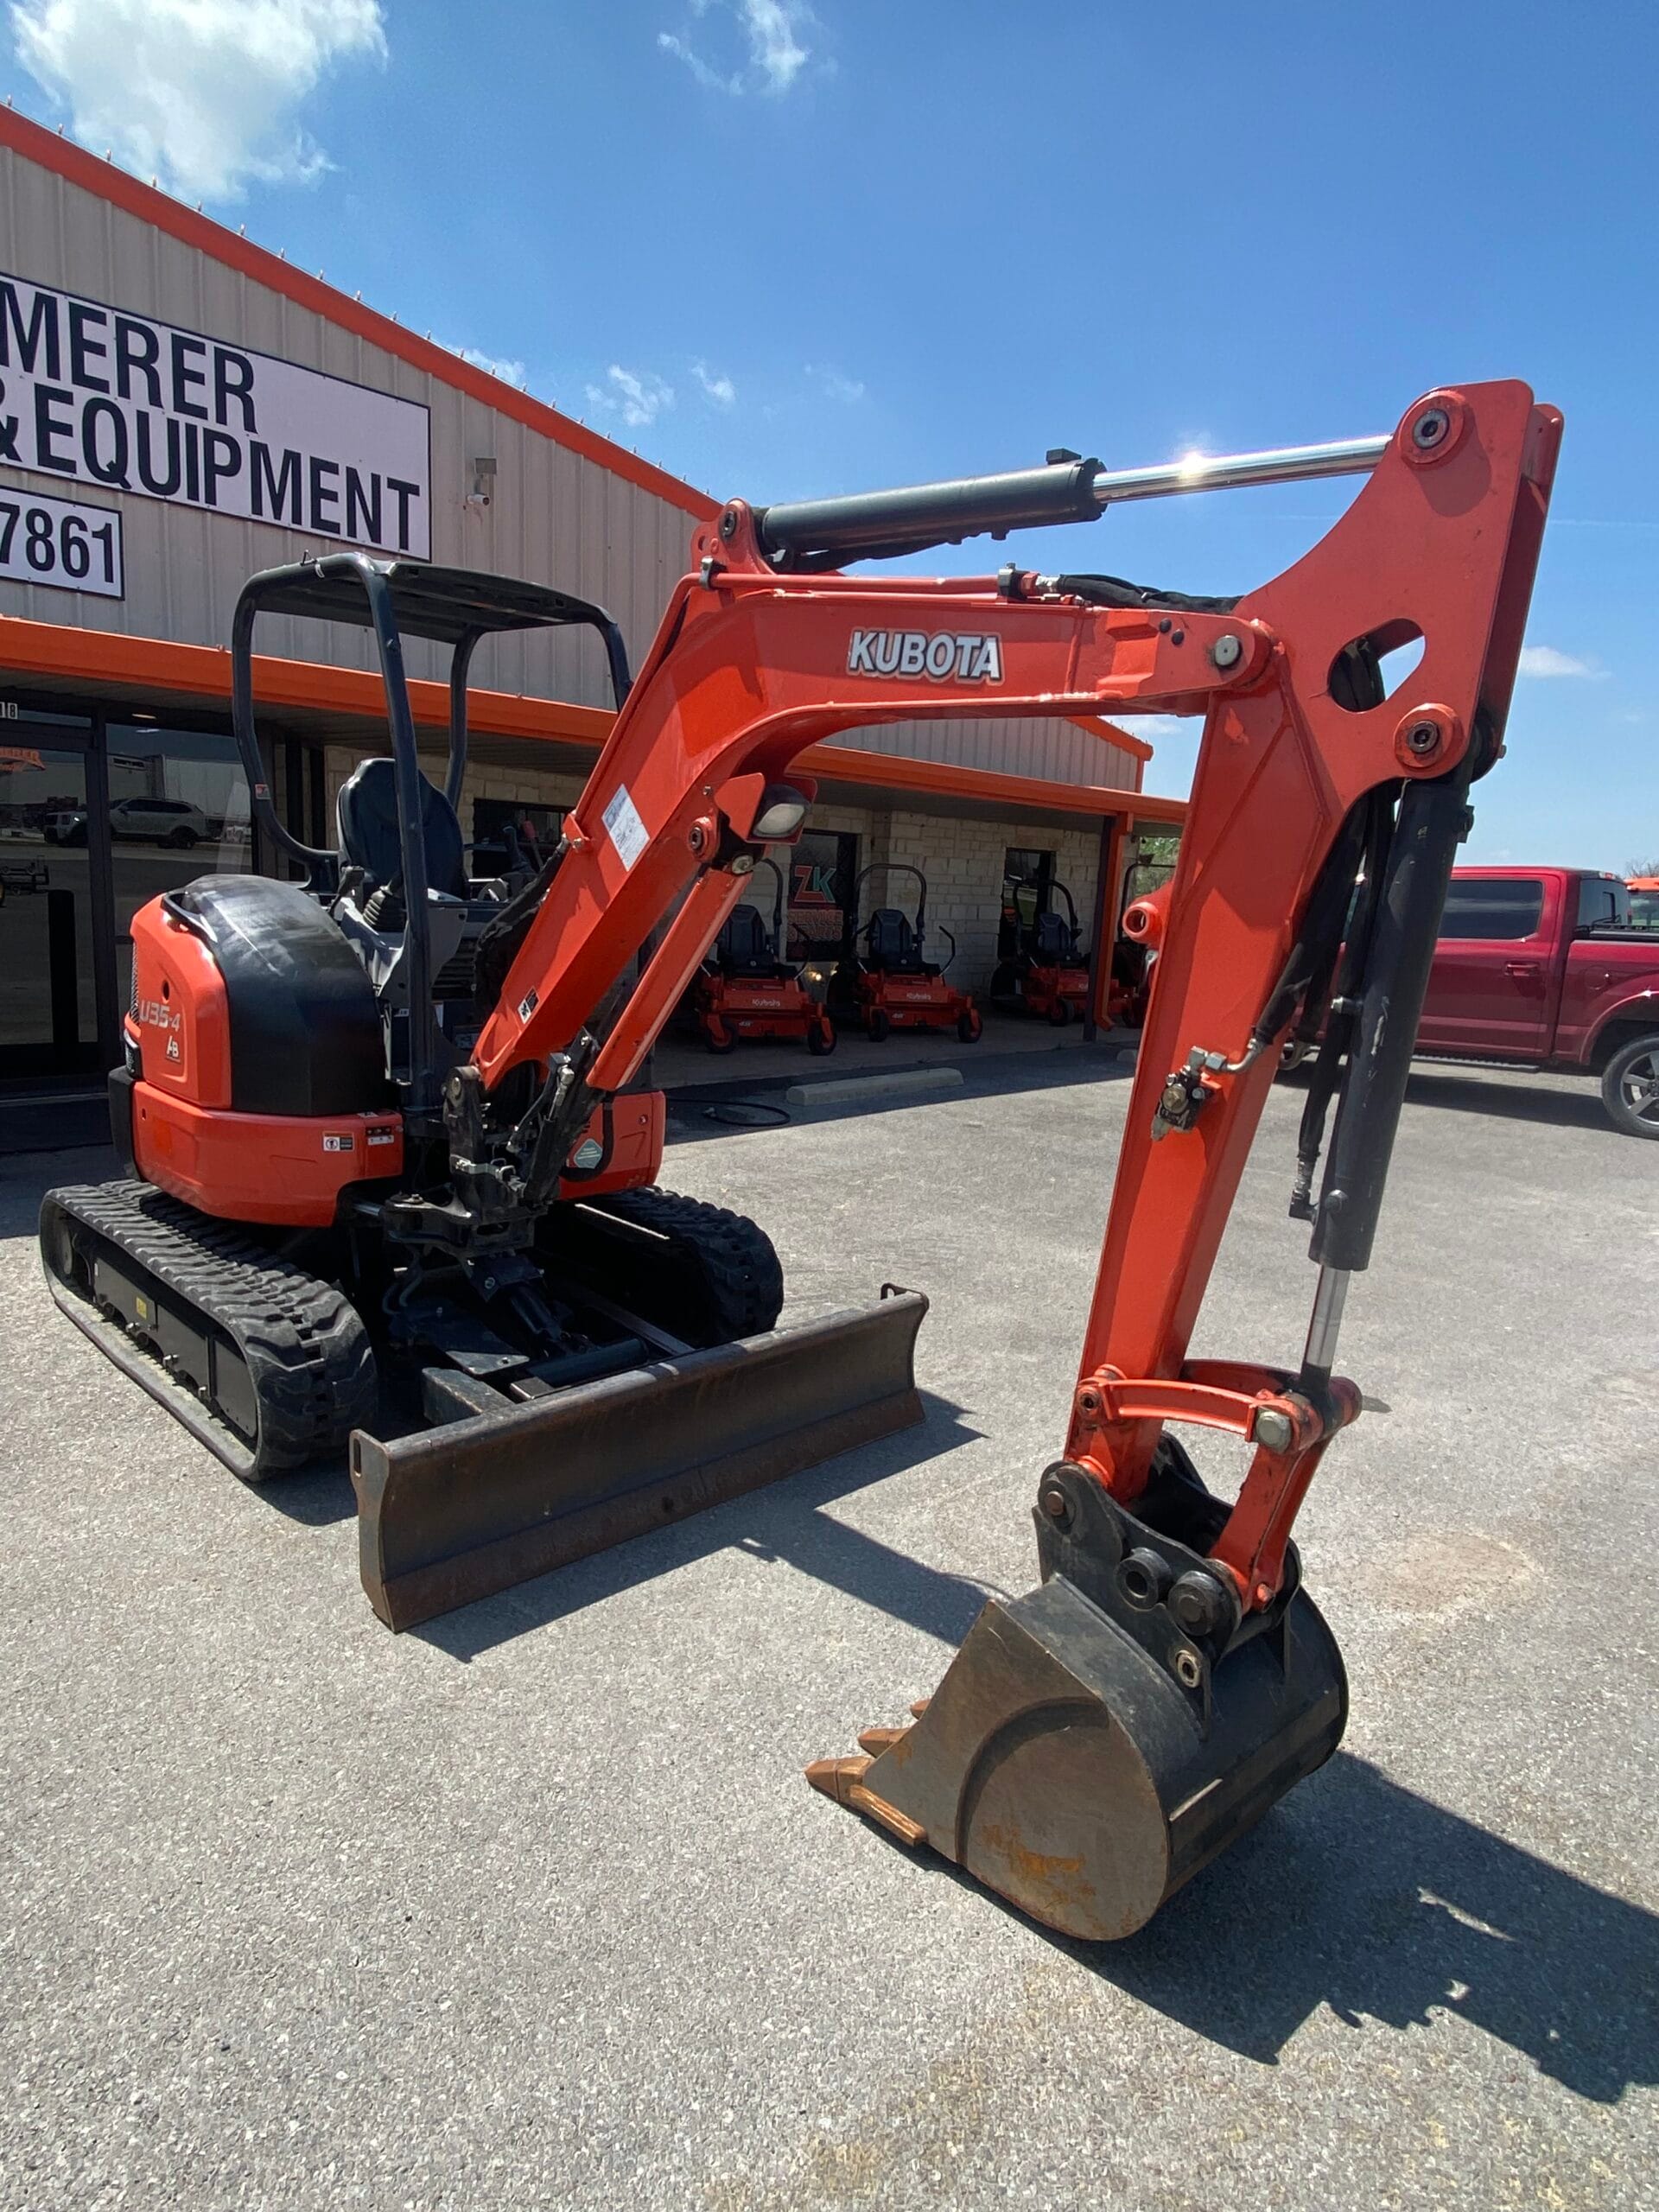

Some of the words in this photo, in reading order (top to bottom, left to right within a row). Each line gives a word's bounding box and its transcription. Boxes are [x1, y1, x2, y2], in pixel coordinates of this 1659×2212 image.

[0, 279, 258, 435] MERER
[0, 501, 114, 583] 7861
[848, 629, 1002, 681] KUBOTA
[794, 865, 837, 904] ZK
[138, 1001, 181, 1033] U35-4
